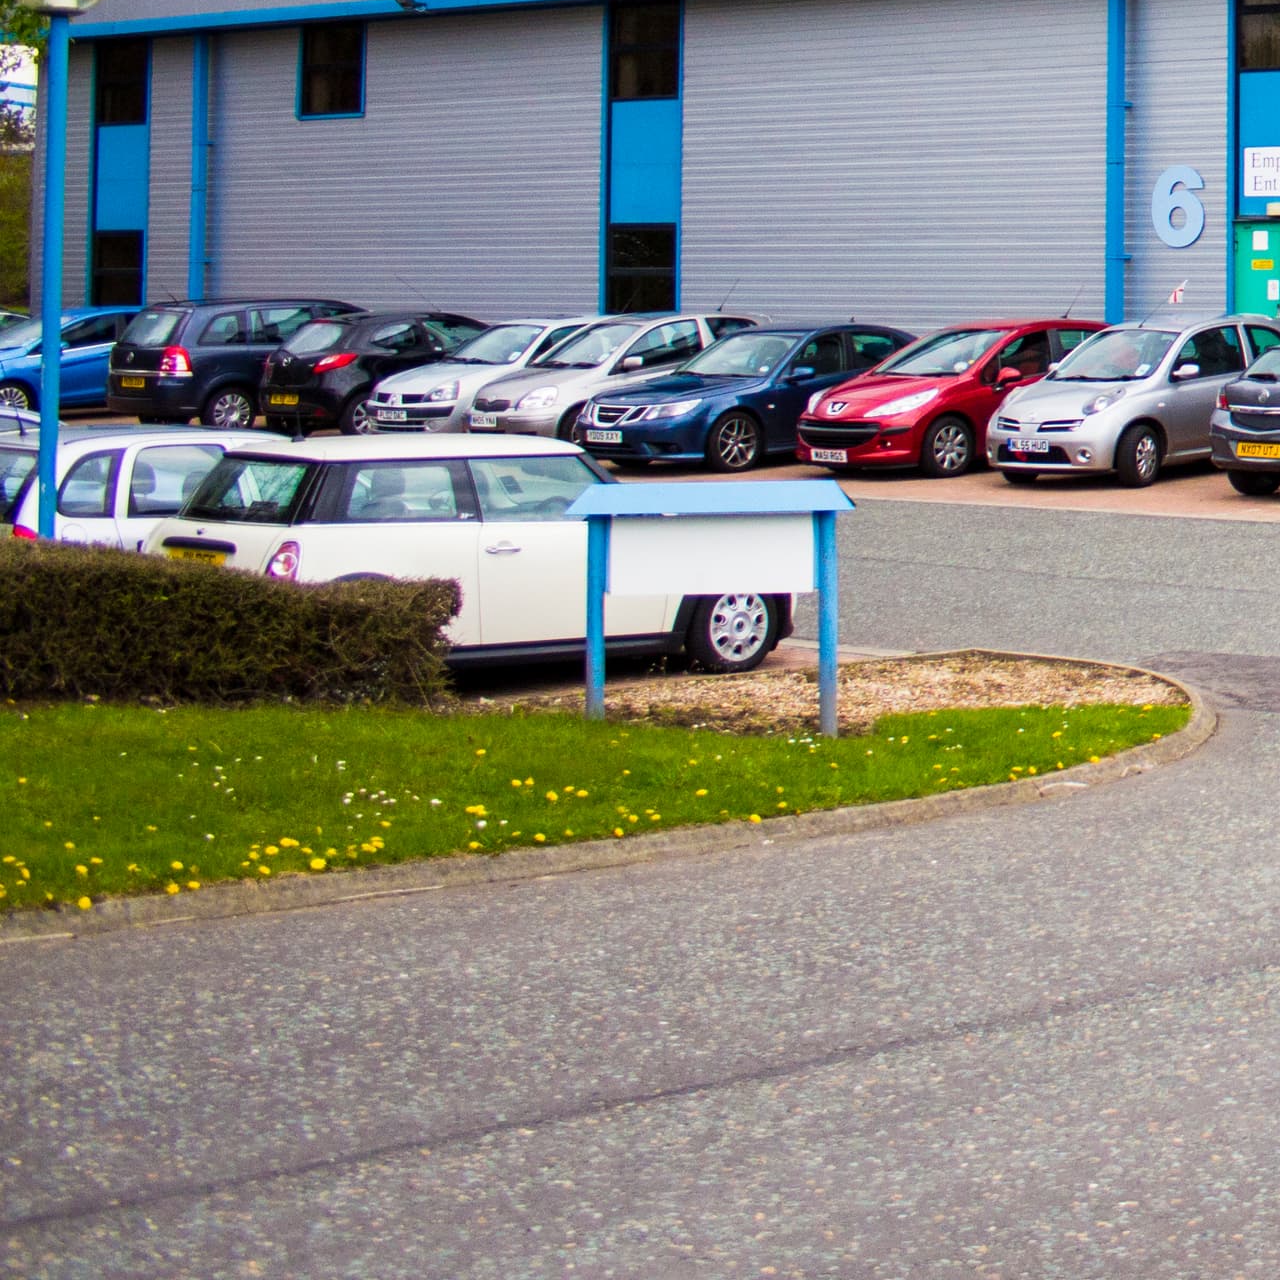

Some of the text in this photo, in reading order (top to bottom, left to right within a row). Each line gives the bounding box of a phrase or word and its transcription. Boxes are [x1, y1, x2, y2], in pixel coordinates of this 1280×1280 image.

[1152, 164, 1205, 249] 6
[1241, 443, 1280, 456] NX07 UTJ
